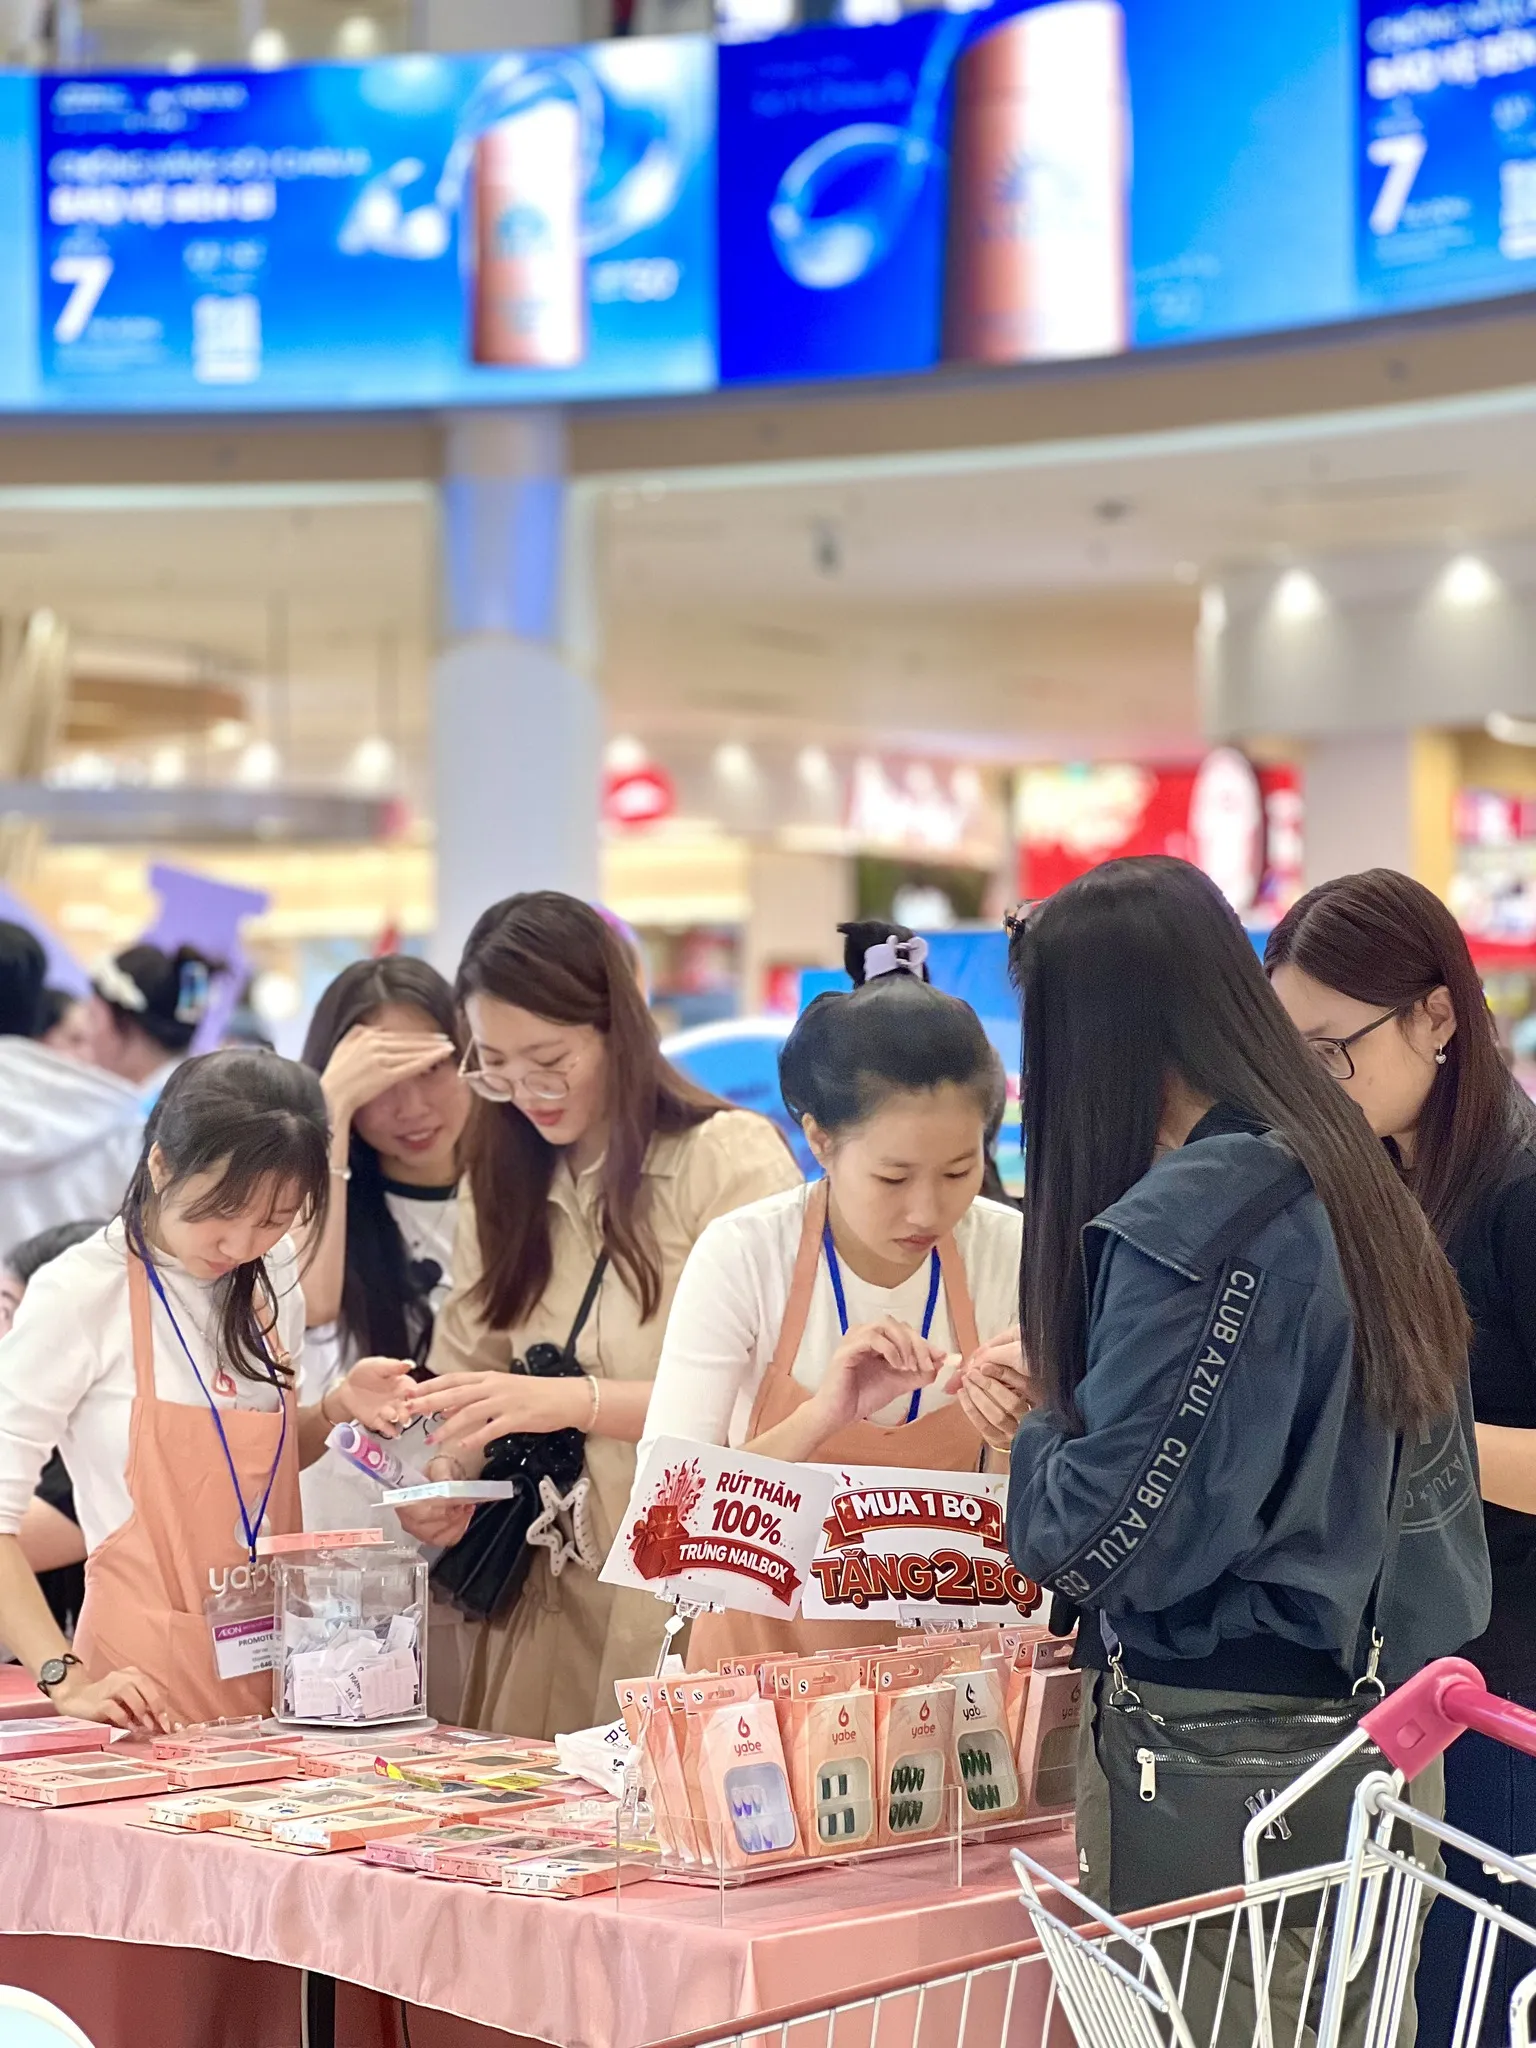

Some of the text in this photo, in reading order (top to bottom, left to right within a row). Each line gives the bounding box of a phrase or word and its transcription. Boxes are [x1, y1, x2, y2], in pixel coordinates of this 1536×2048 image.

[1367, 132, 1427, 236] 7
[51, 256, 114, 344] 7
[1213, 1269, 1255, 1344] CLUB
[1179, 1345, 1226, 1417] AZUL
[1136, 1437, 1187, 1509] CLUB
[716, 1469, 802, 1513] RÚT THĂM
[712, 1498, 782, 1545] 100%
[850, 1491, 982, 1526] MUA 1 BỘ
[1085, 1507, 1148, 1569] AZUL
[679, 1541, 789, 1584] TRÚNG NAILBOX
[811, 1549, 933, 1609] TẶNG
[930, 1549, 980, 1605] 2
[238, 1633, 281, 1647] PROMOTE
[1021, 1647, 1026, 1657] S
[800, 1681, 807, 1692] S
[884, 1675, 890, 1684] S
[626, 1691, 633, 1702] S
[660, 1689, 667, 1700] S
[694, 1691, 704, 1701] XS
[963, 1705, 981, 1721] yab
[832, 1729, 857, 1745] yabe
[912, 1723, 936, 1739] yabe
[734, 1740, 762, 1757] yabe
